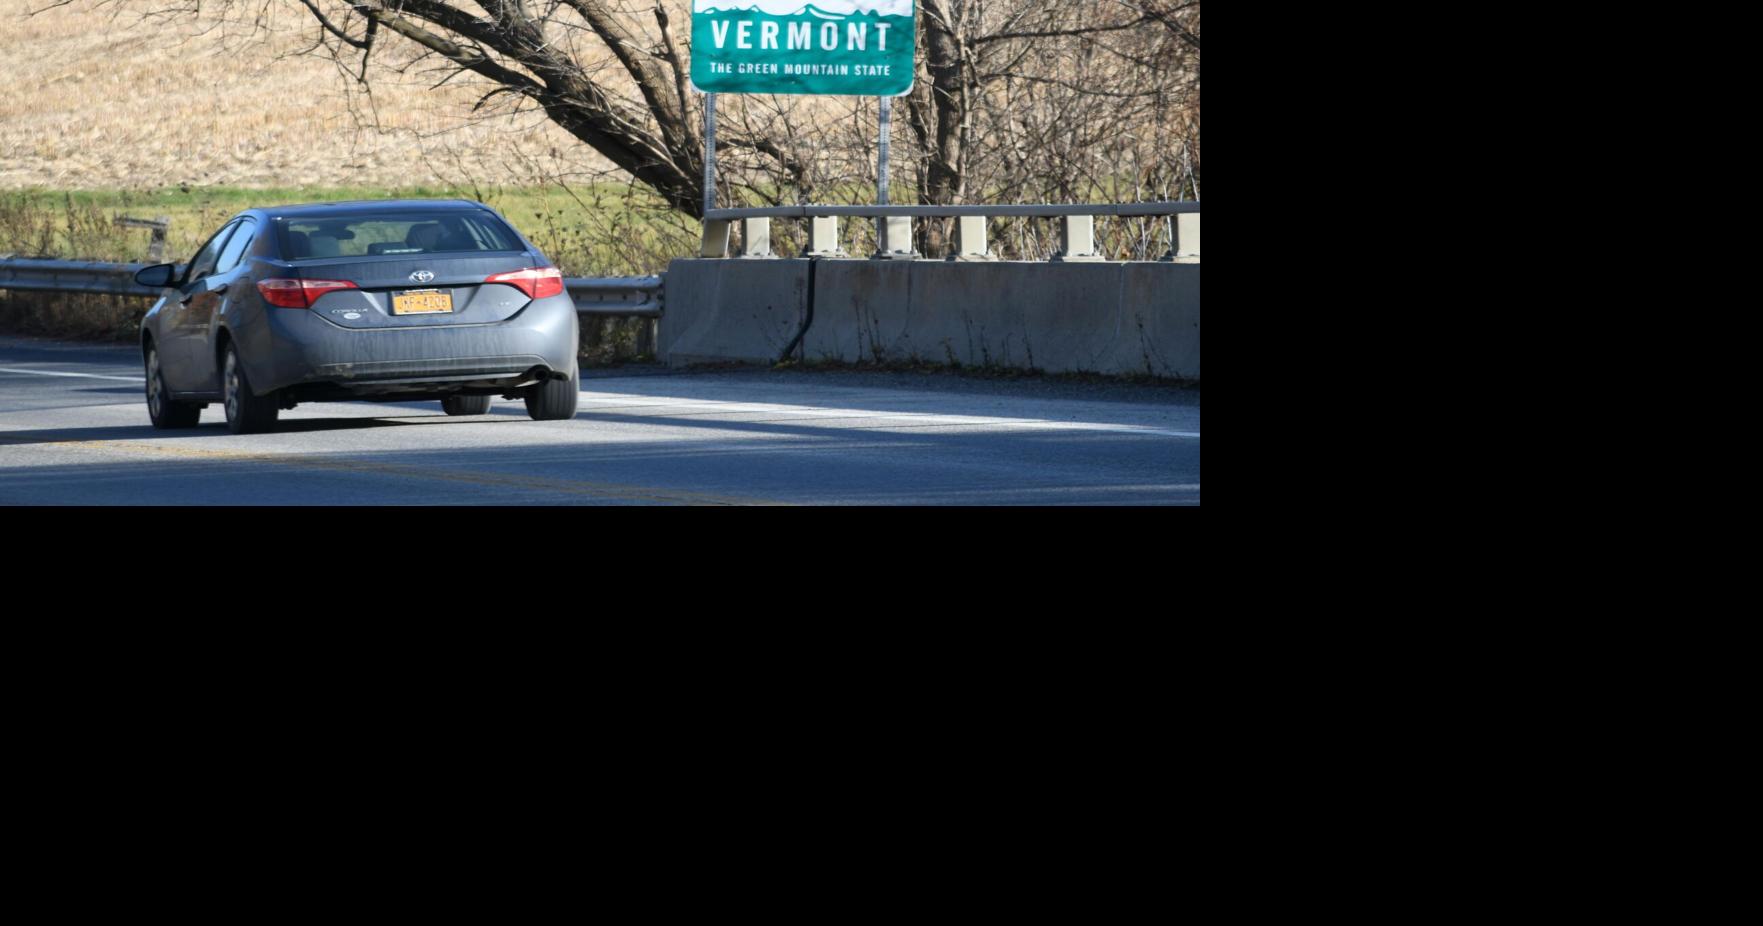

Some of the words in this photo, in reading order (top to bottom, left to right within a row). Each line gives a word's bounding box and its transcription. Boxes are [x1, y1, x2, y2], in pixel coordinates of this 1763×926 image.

[711, 20, 891, 51] VERMONT
[710, 62, 732, 74] THE
[738, 63, 778, 75] GREEN
[784, 63, 848, 76] MOUNTAIN
[854, 64, 891, 76] STATE
